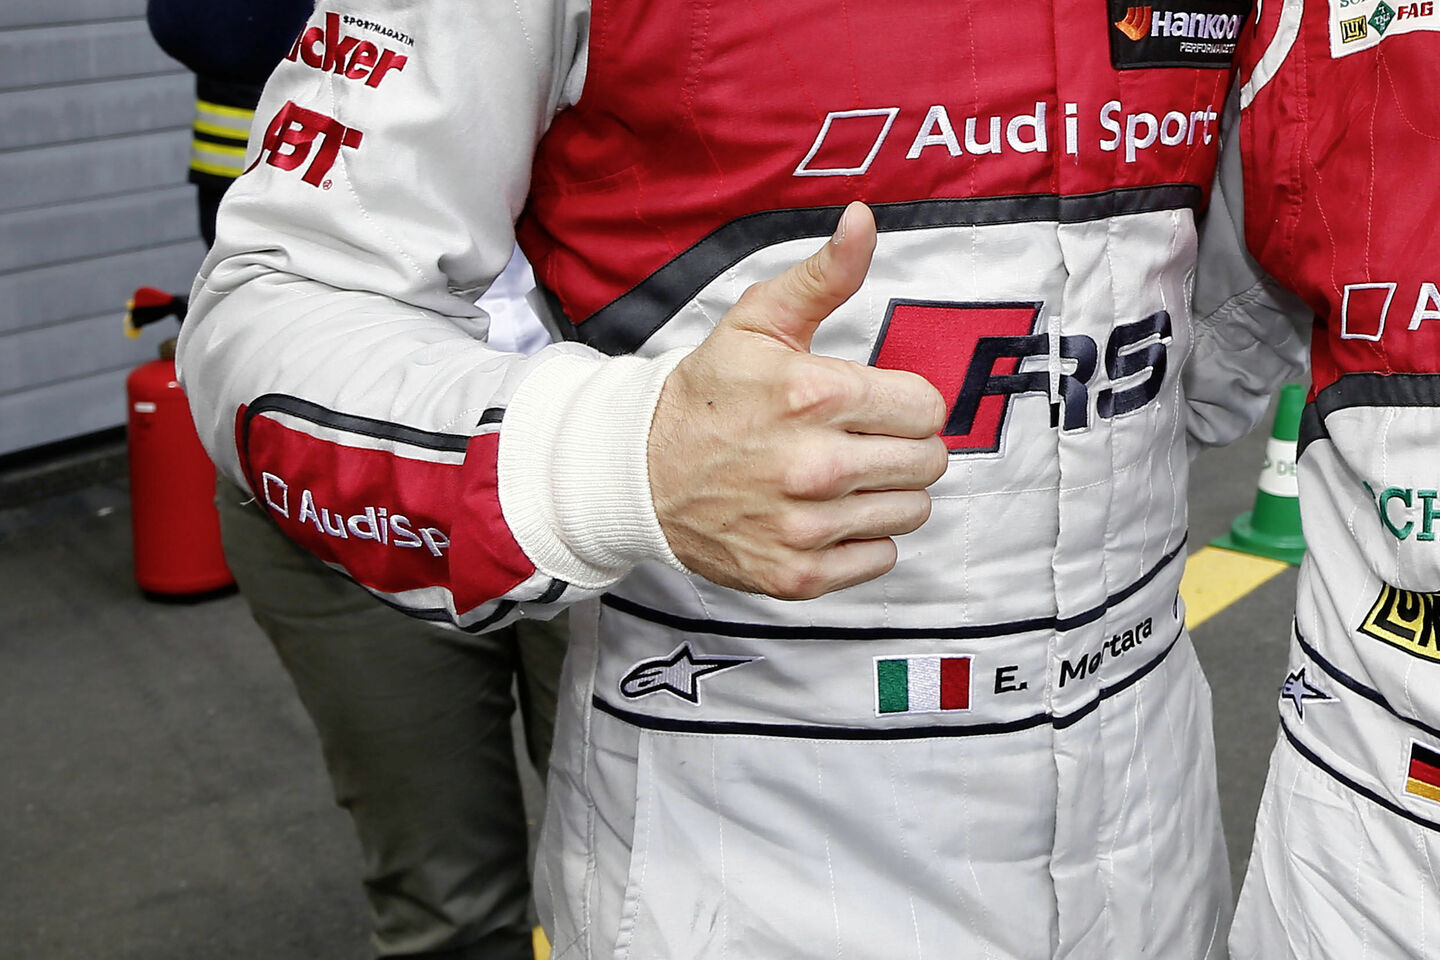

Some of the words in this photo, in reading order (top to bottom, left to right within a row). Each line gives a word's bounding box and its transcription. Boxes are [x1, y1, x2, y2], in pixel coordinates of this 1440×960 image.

[343, 15, 415, 48] SPORTMAGAZIN
[1397, 1, 1434, 21] FAG
[284, 11, 408, 89] icker
[905, 101, 1079, 160] Audi
[1099, 99, 1218, 164] Sport
[943, 309, 1174, 437] RS
[994, 665, 1028, 695] E.
[1058, 616, 1153, 689] Mortara
